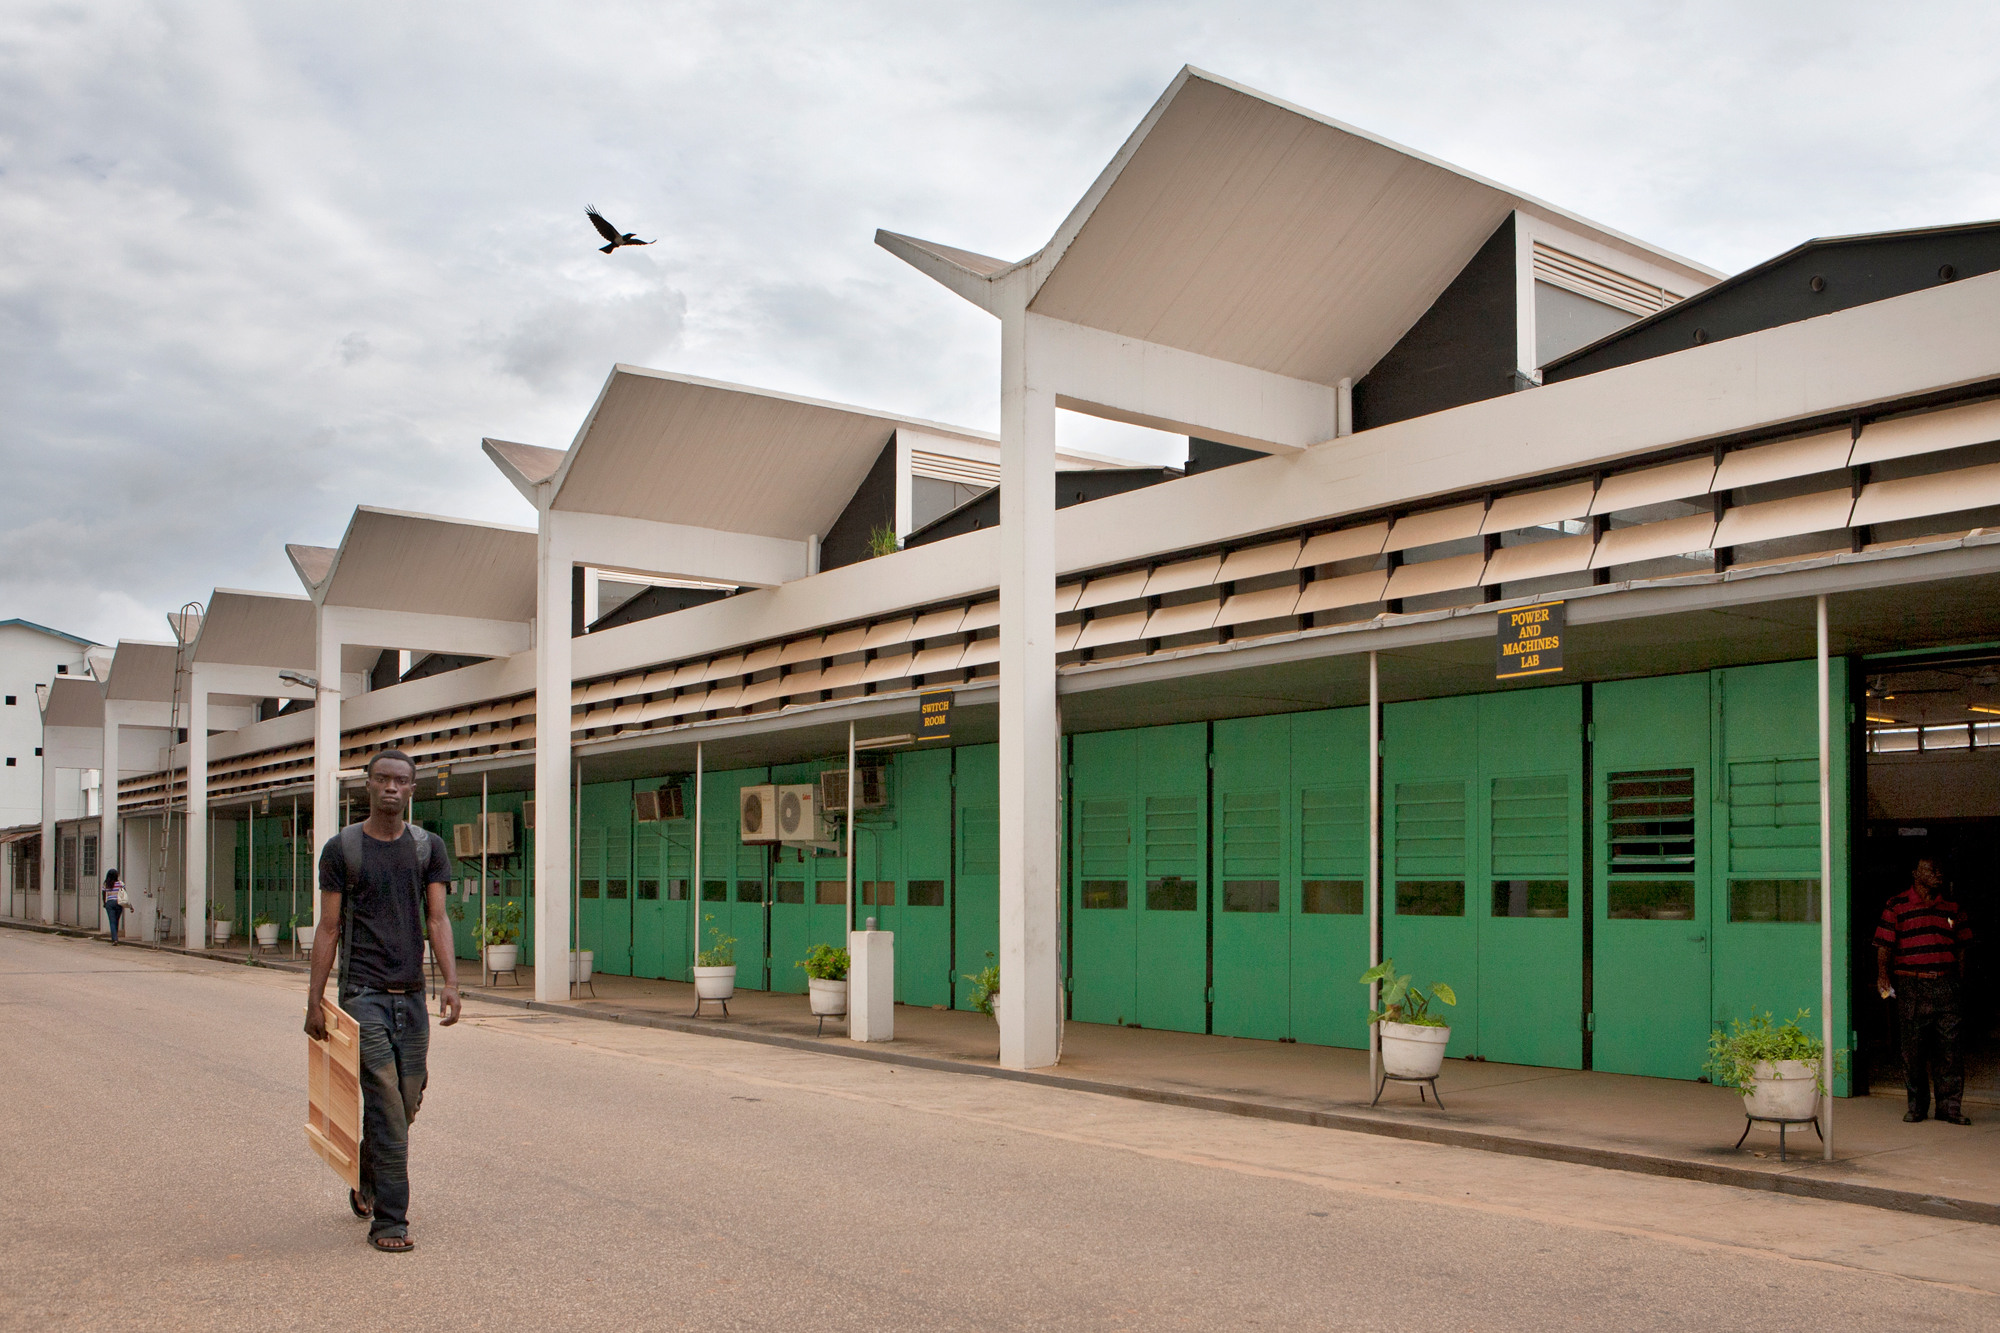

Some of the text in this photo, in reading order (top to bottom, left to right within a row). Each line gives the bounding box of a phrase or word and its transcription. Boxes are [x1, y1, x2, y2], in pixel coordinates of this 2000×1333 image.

[1511, 609, 1549, 626] POWER
[1518, 624, 1541, 639] AND
[1503, 635, 1559, 656] MACHINES
[1521, 654, 1540, 668] LAB
[922, 701, 949, 714] SWITCH
[924, 714, 946, 727] ROOM
